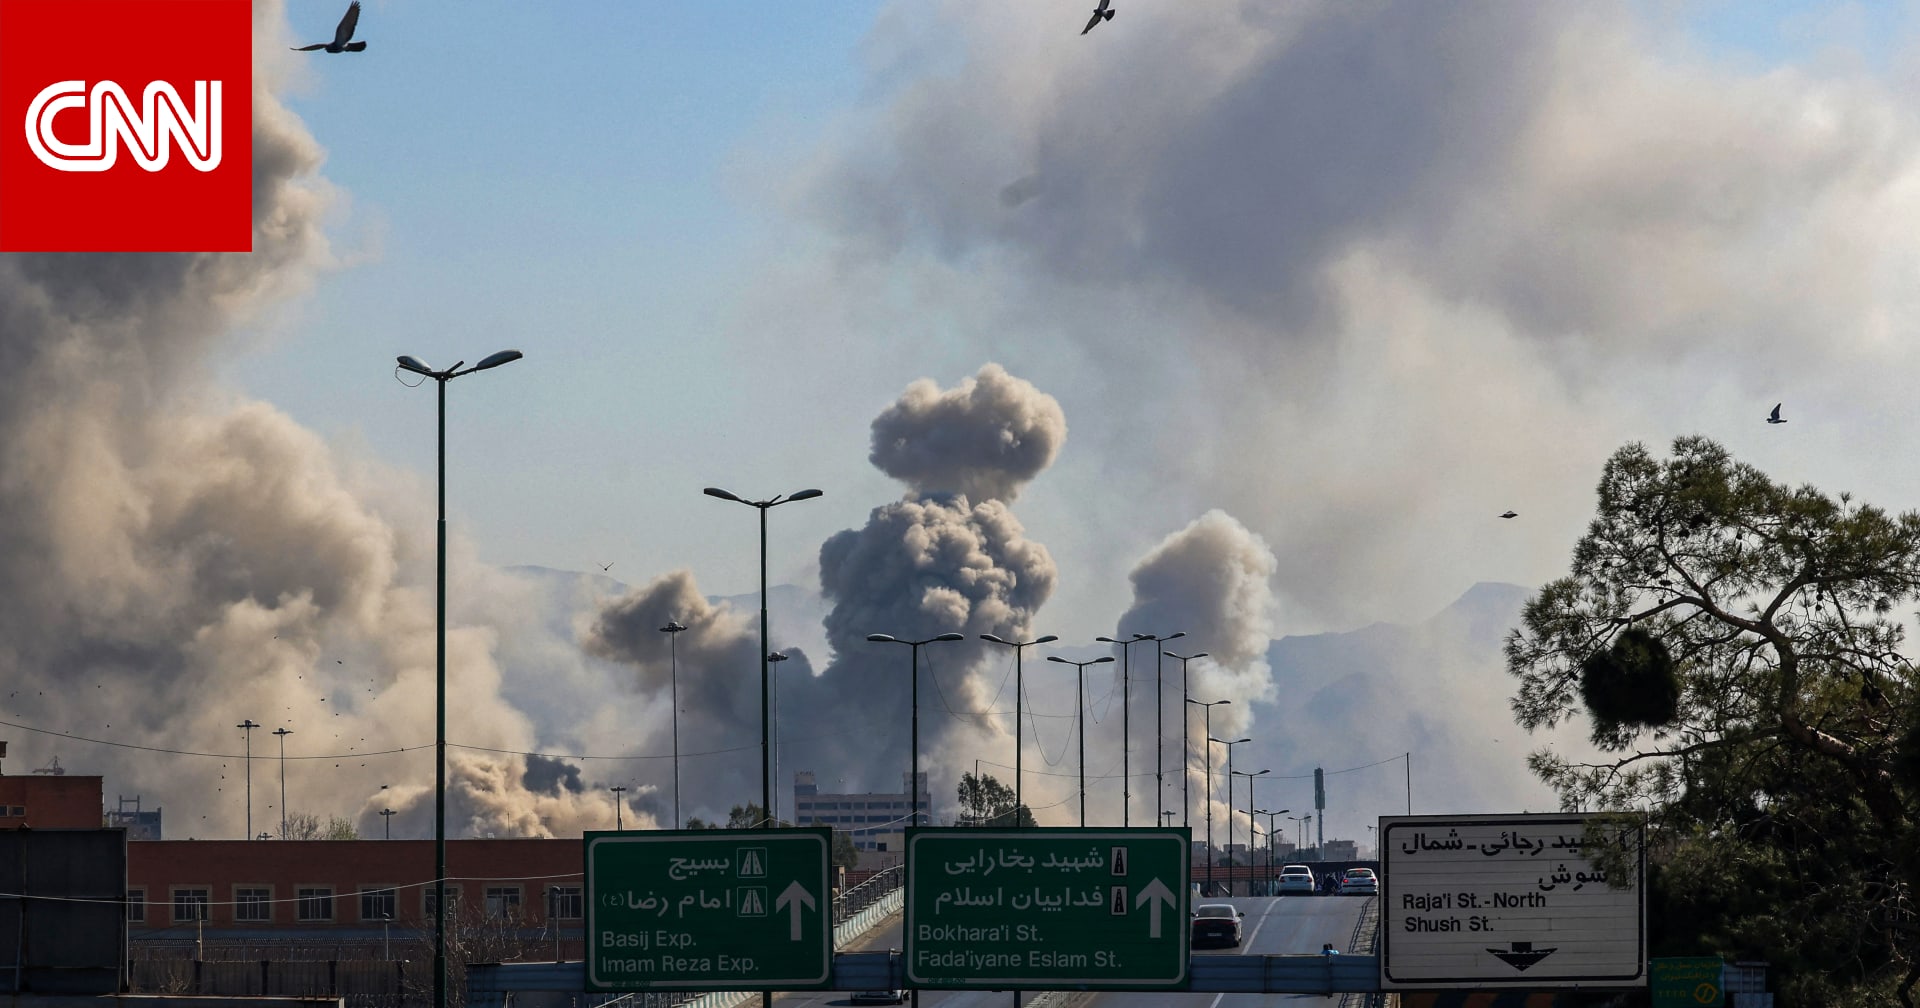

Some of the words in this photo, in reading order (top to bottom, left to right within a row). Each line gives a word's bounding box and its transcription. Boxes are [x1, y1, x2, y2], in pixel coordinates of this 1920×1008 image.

[1402, 829, 1462, 855] شمال
[668, 857, 730, 881] بسیج
[944, 848, 1035, 877] بخارایی
[1042, 847, 1104, 873] شهید
[679, 889, 731, 918] امام
[935, 887, 1003, 915] اسلام
[1012, 886, 1104, 912] فداییان
[1402, 893, 1451, 912] Raja'i
[919, 924, 1009, 942] Bokhara'i
[1016, 924, 1044, 942] St.
[1405, 916, 1461, 932] Shush
[1469, 916, 1494, 932] St.
[602, 931, 649, 950] Basij
[656, 930, 697, 949] Exp.
[602, 956, 654, 973] Imam
[662, 955, 711, 972] Reza
[718, 955, 759, 974] Exp.
[918, 950, 1022, 970] Fada'iyane
[1029, 950, 1087, 968] Eslam
[1094, 950, 1122, 968] St.
